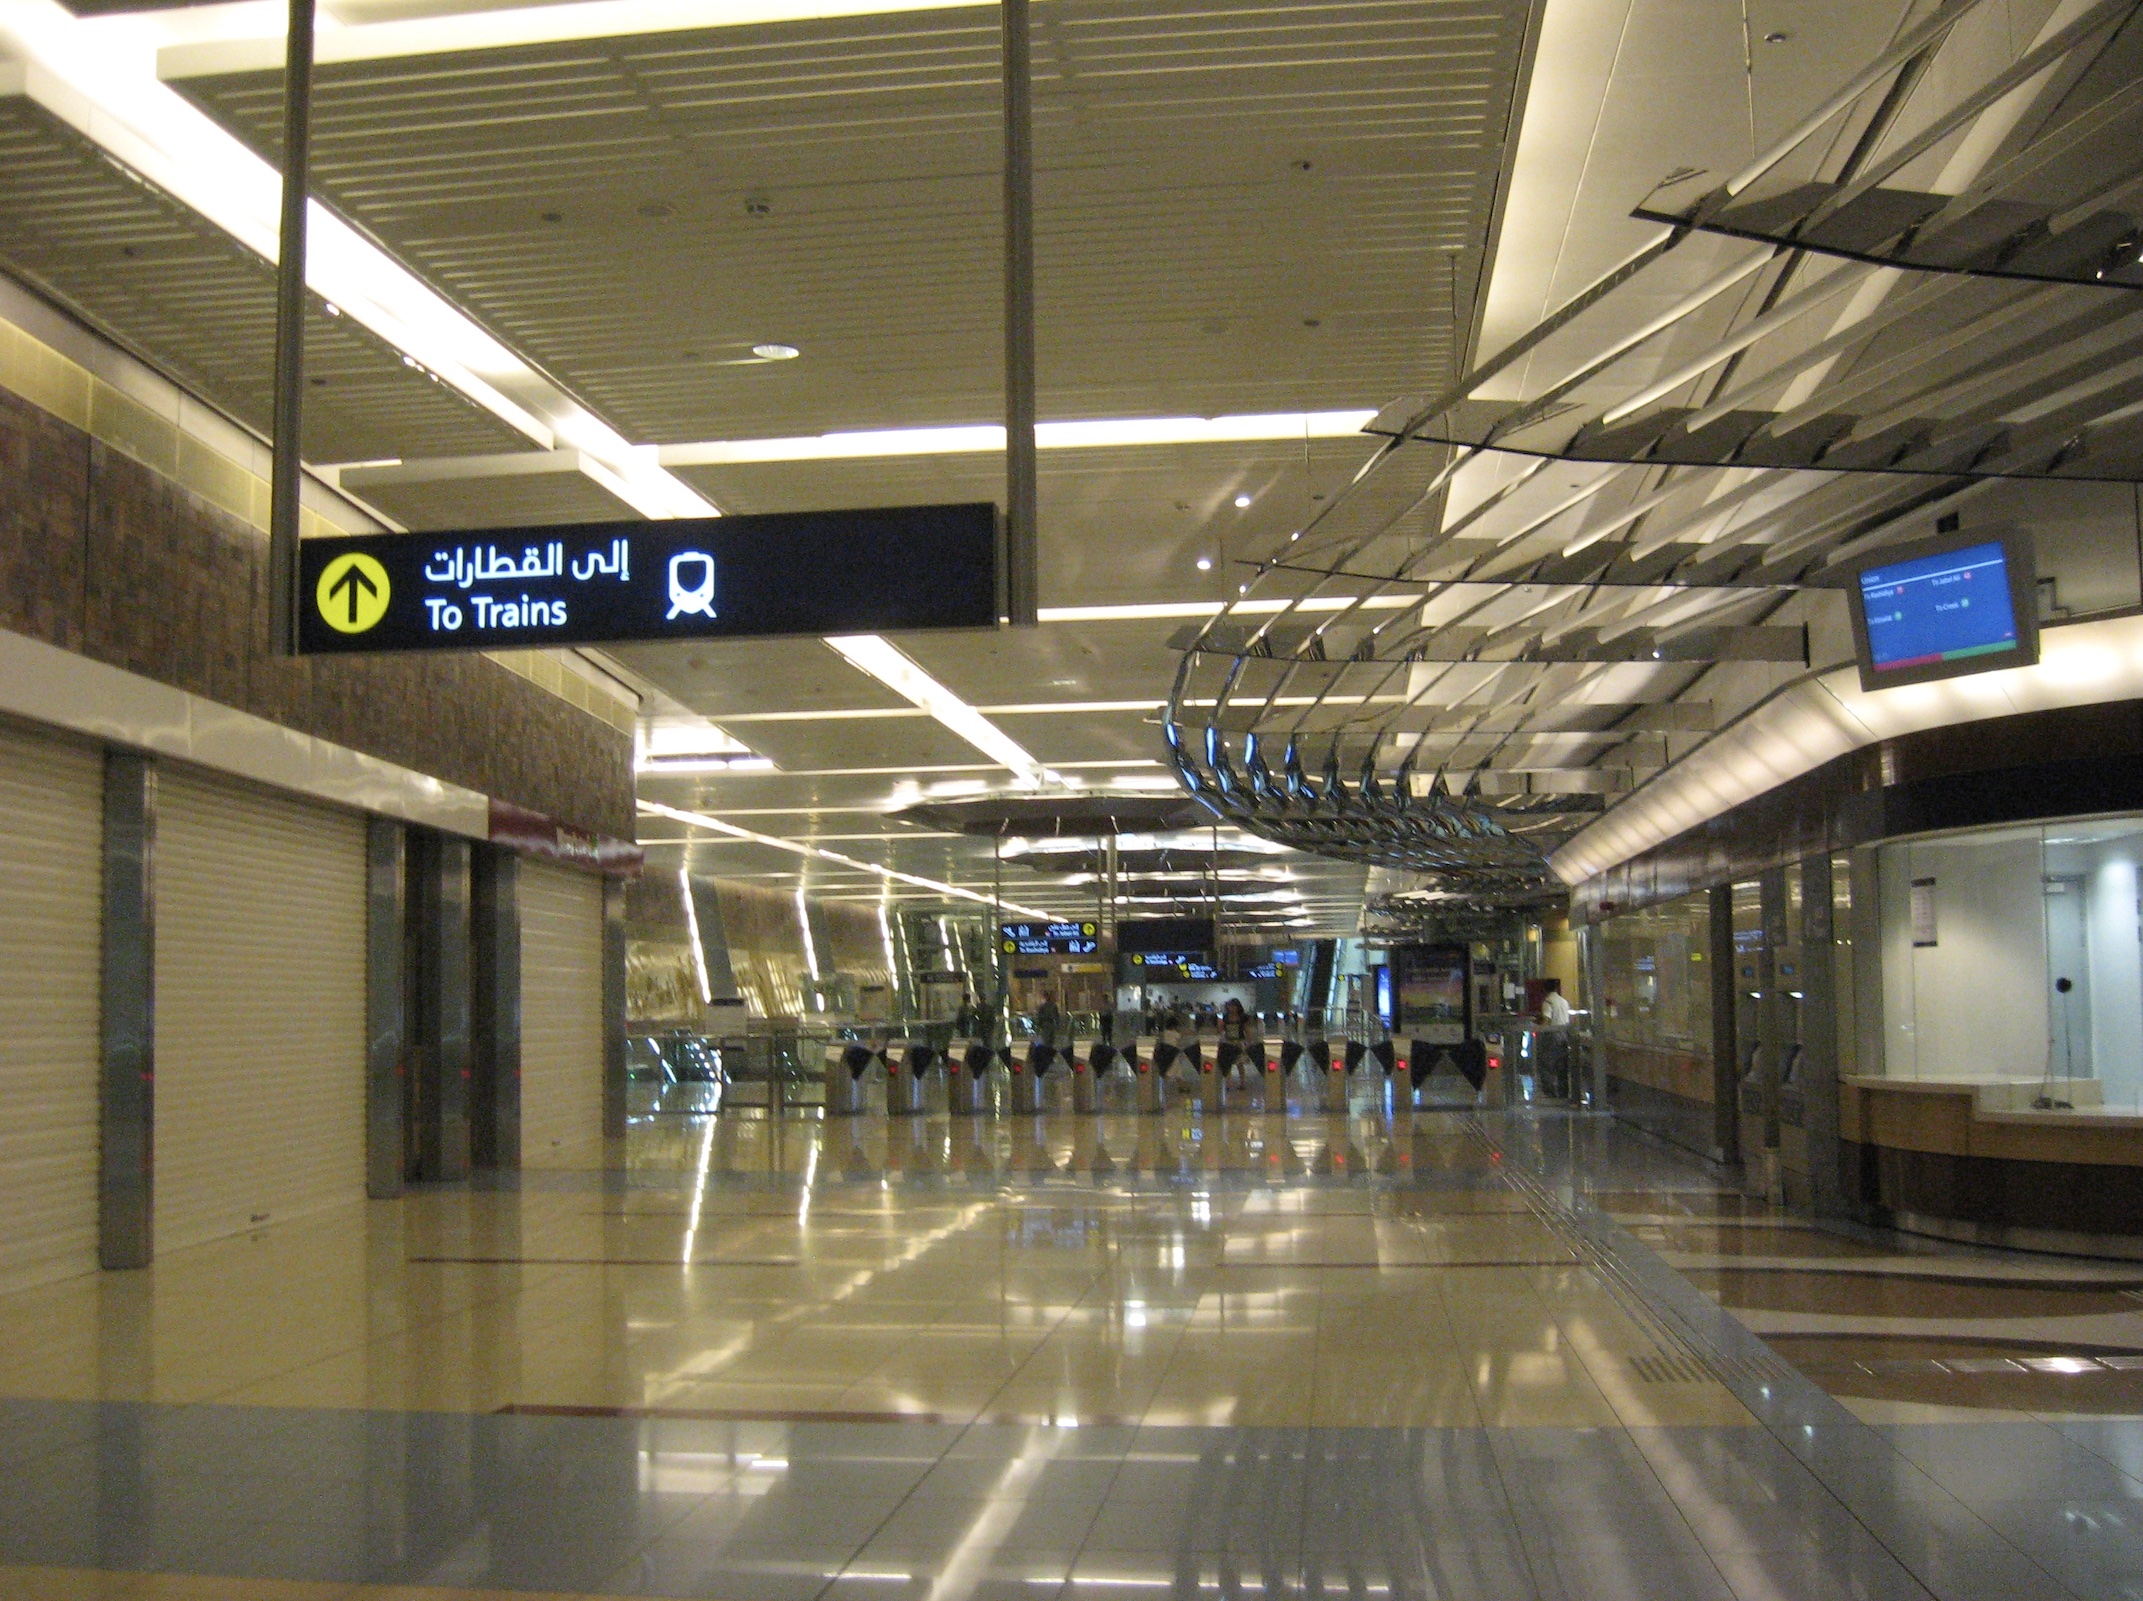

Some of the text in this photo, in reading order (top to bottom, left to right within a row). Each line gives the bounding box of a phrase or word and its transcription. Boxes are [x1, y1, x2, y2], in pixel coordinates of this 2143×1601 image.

[424, 538, 631, 589] إلى القطارات
[424, 593, 568, 631] To Trains
